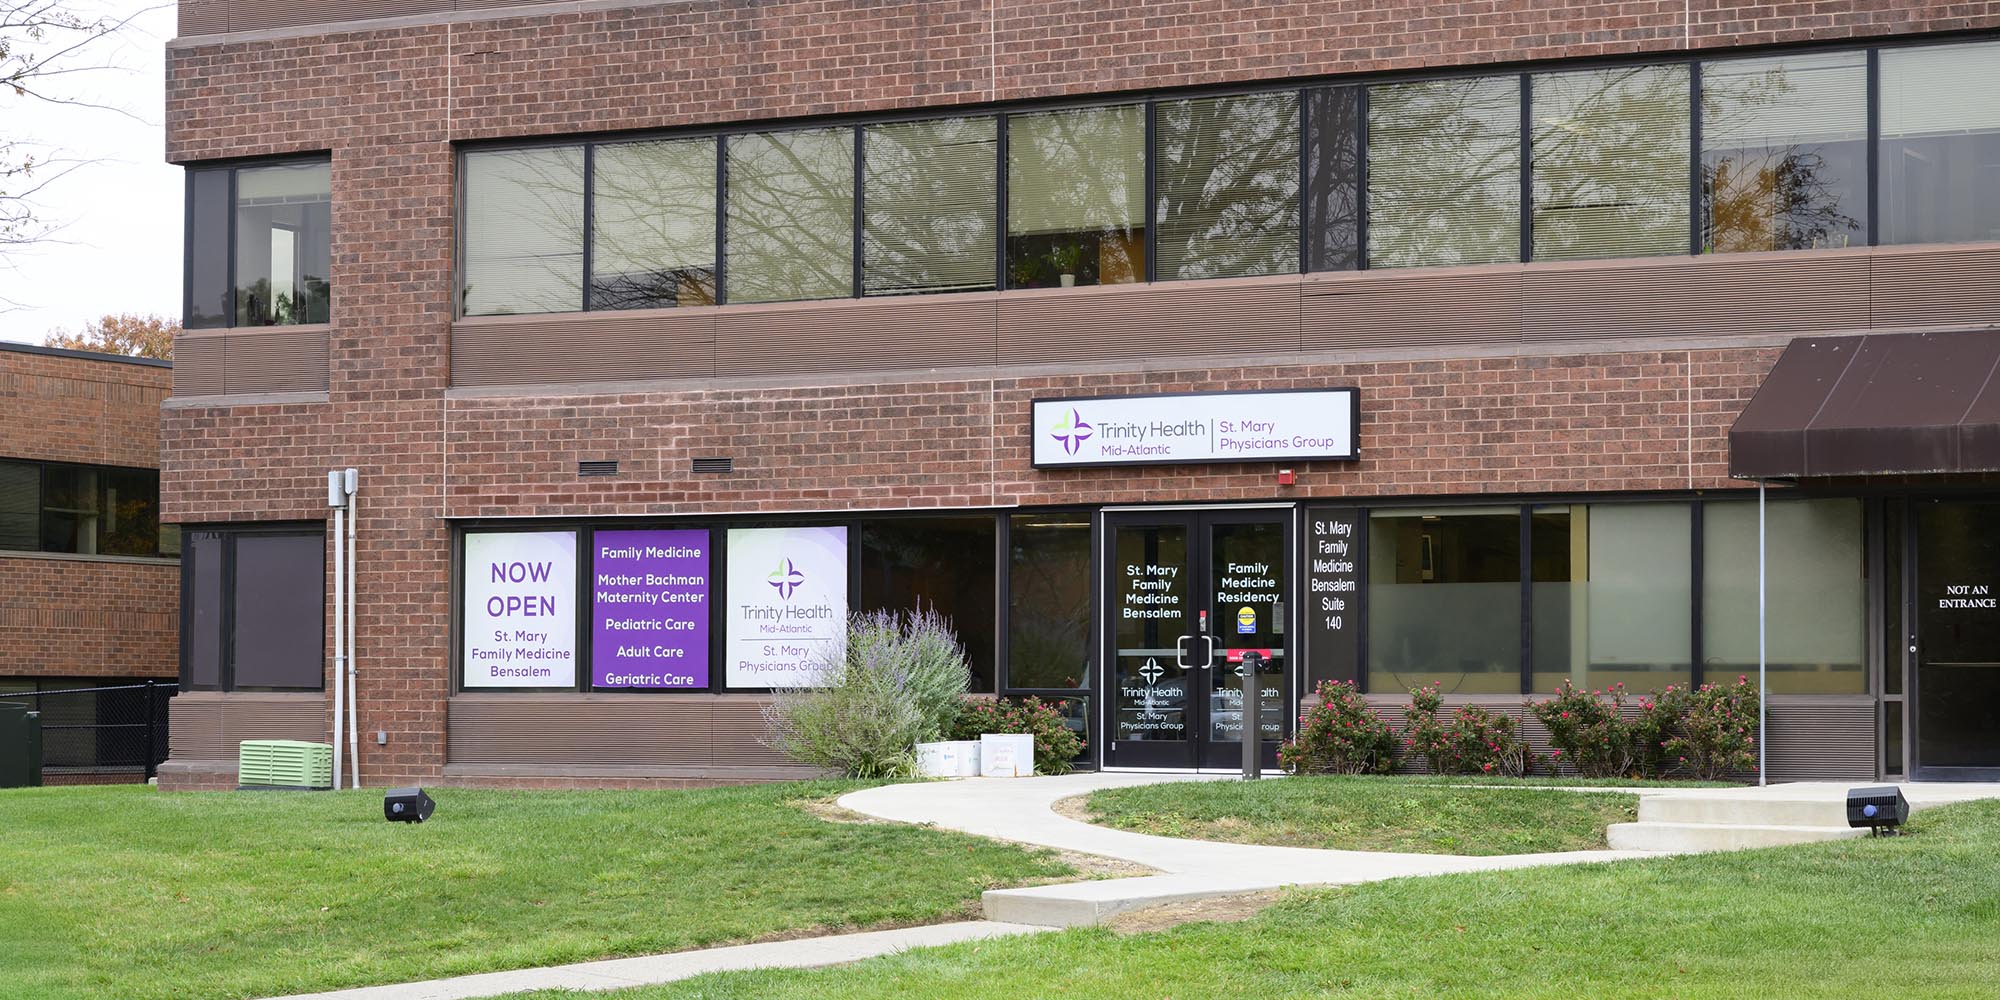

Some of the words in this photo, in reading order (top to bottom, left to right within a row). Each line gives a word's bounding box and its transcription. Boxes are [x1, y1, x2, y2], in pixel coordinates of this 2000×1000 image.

[1098, 422, 1147, 441] Trinity
[1150, 420, 1205, 437] Health
[1220, 421, 1238, 433] St.
[1241, 420, 1275, 434] Mary
[1101, 444, 1171, 456] Mid-Atlantic
[1220, 437, 1289, 452] Physicians
[1294, 436, 1334, 450] Group
[1315, 522, 1327, 534] St.
[1330, 522, 1351, 537] Mary
[601, 547, 642, 560] Family
[646, 547, 701, 559] Medicine
[1319, 540, 1348, 556] Family
[1127, 566, 1144, 576] St.
[1147, 566, 1178, 578] Mary
[1228, 563, 1269, 575] Family
[1314, 560, 1353, 572] Medicine
[491, 562, 552, 583] NOW
[598, 575, 642, 586] Mother
[646, 574, 704, 586] Bachman
[1132, 580, 1171, 592] Family
[1222, 578, 1276, 588] Medicine
[1311, 579, 1355, 591] Bensalem
[1947, 585, 1970, 594] NOT
[1972, 586, 1988, 594] AN
[597, 592, 657, 605] Maternity
[661, 592, 704, 604] Center
[1126, 594, 1179, 604] Medicine
[1217, 592, 1279, 605] Residency
[1322, 598, 1344, 611] Suite
[1939, 599, 1996, 608] ENTRANCE
[487, 596, 555, 617] OPEN
[741, 606, 783, 623] Trinity
[786, 605, 832, 619] Health
[1124, 608, 1181, 618] Bensalem
[606, 619, 662, 631] Pediatric
[665, 619, 695, 630] Care
[760, 625, 812, 633] Mid-Atlantic
[1326, 617, 1341, 629] 140
[494, 630, 513, 643] St.
[516, 631, 547, 644] Mary
[471, 648, 513, 661] Family
[516, 648, 570, 660] Medicine
[617, 646, 651, 658] Adult
[654, 646, 683, 658] Care
[764, 646, 778, 656] St.
[781, 646, 809, 658] Mary
[490, 665, 551, 677] Bensalem
[740, 661, 796, 673] Physicians
[605, 673, 660, 686] Geriatric
[663, 674, 694, 685] Care
[1122, 688, 1149, 698] Trinity
[1152, 687, 1182, 697] Health
[1217, 688, 1243, 699] Trinity
[1261, 688, 1279, 697] alth
[1149, 713, 1167, 721] Mary
[1121, 723, 1158, 731] Physicians
[1161, 723, 1184, 731] Group
[1262, 724, 1279, 732] roup
